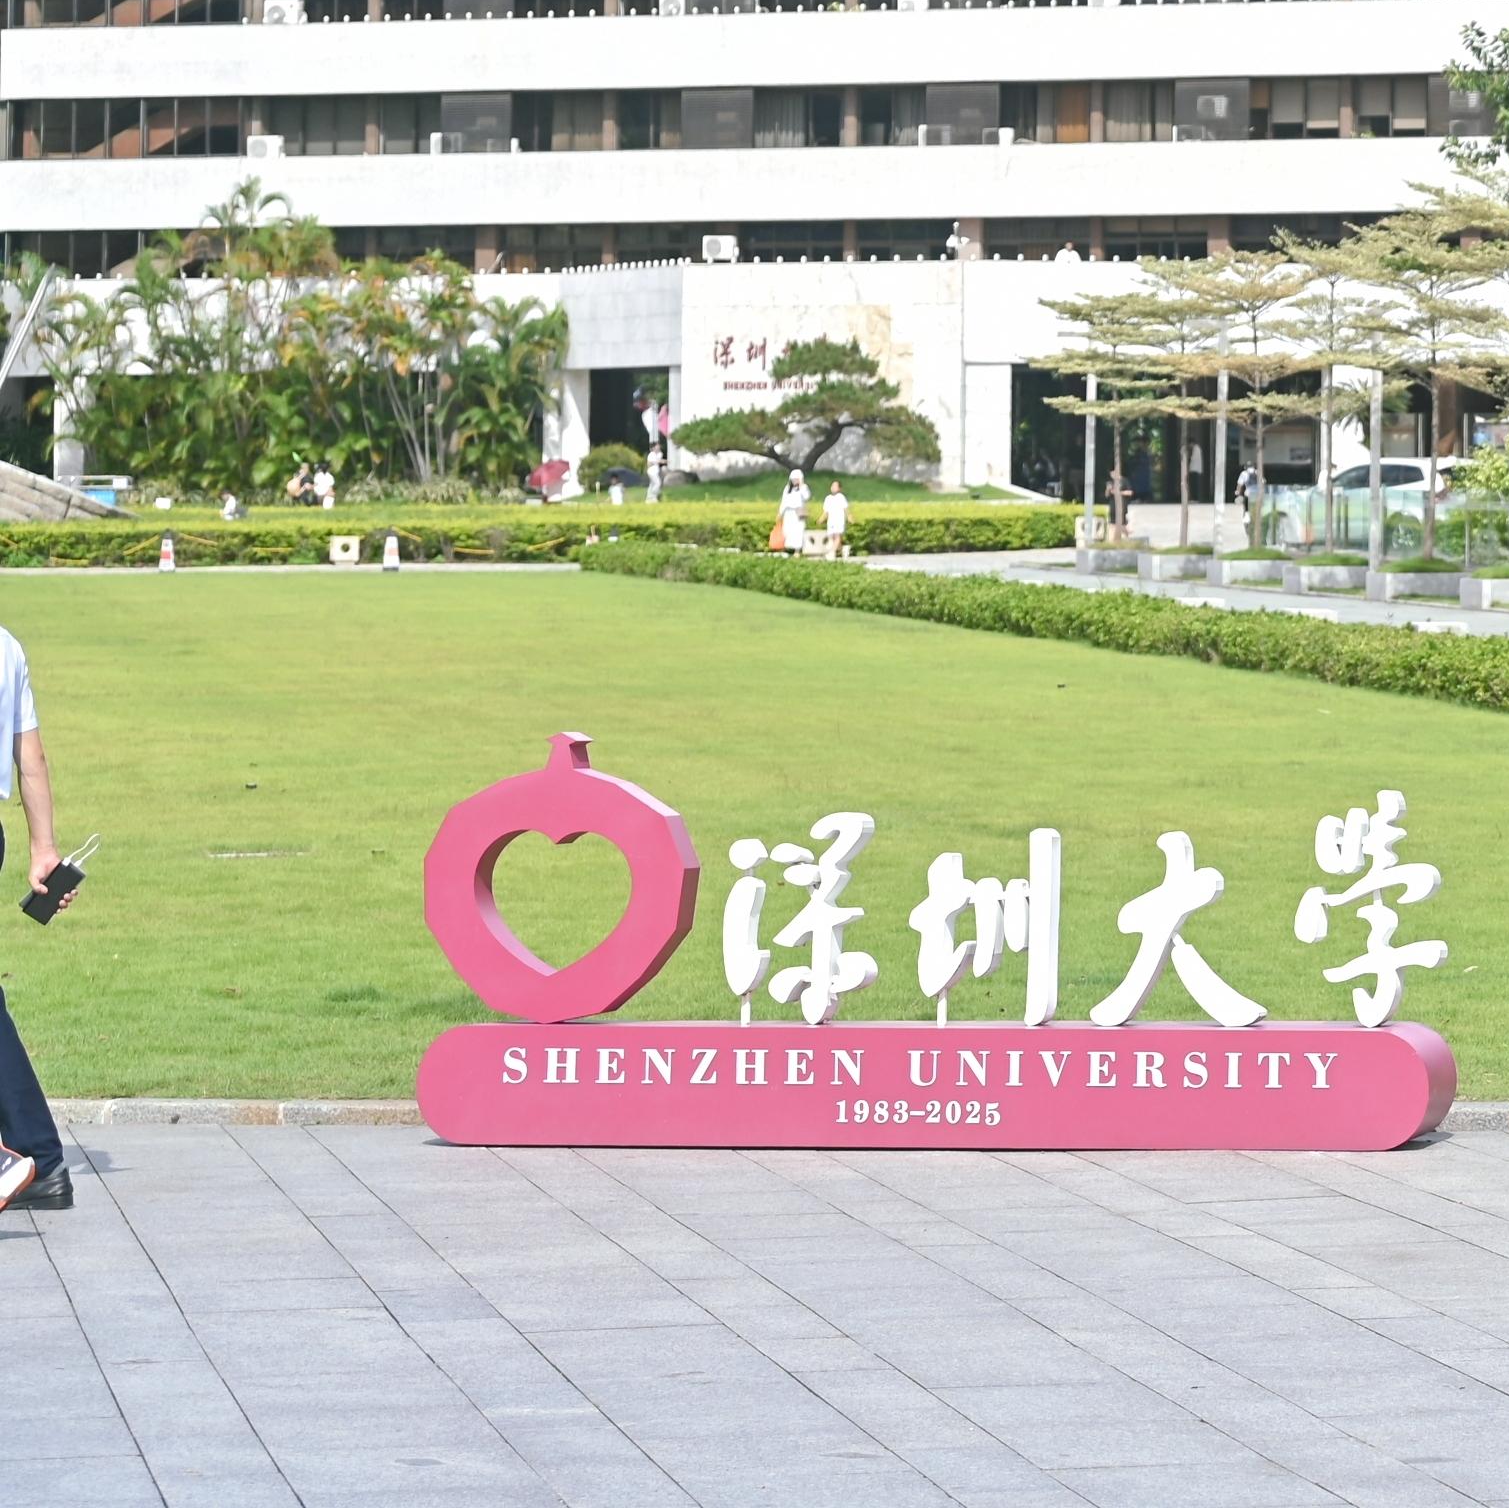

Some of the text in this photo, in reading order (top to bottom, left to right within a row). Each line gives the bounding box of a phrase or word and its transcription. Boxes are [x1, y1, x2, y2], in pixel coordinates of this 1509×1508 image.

[502, 1047, 1339, 1089] SHENZHEN UNIVERSITY
[835, 1098, 1002, 1127] 1983-2025
